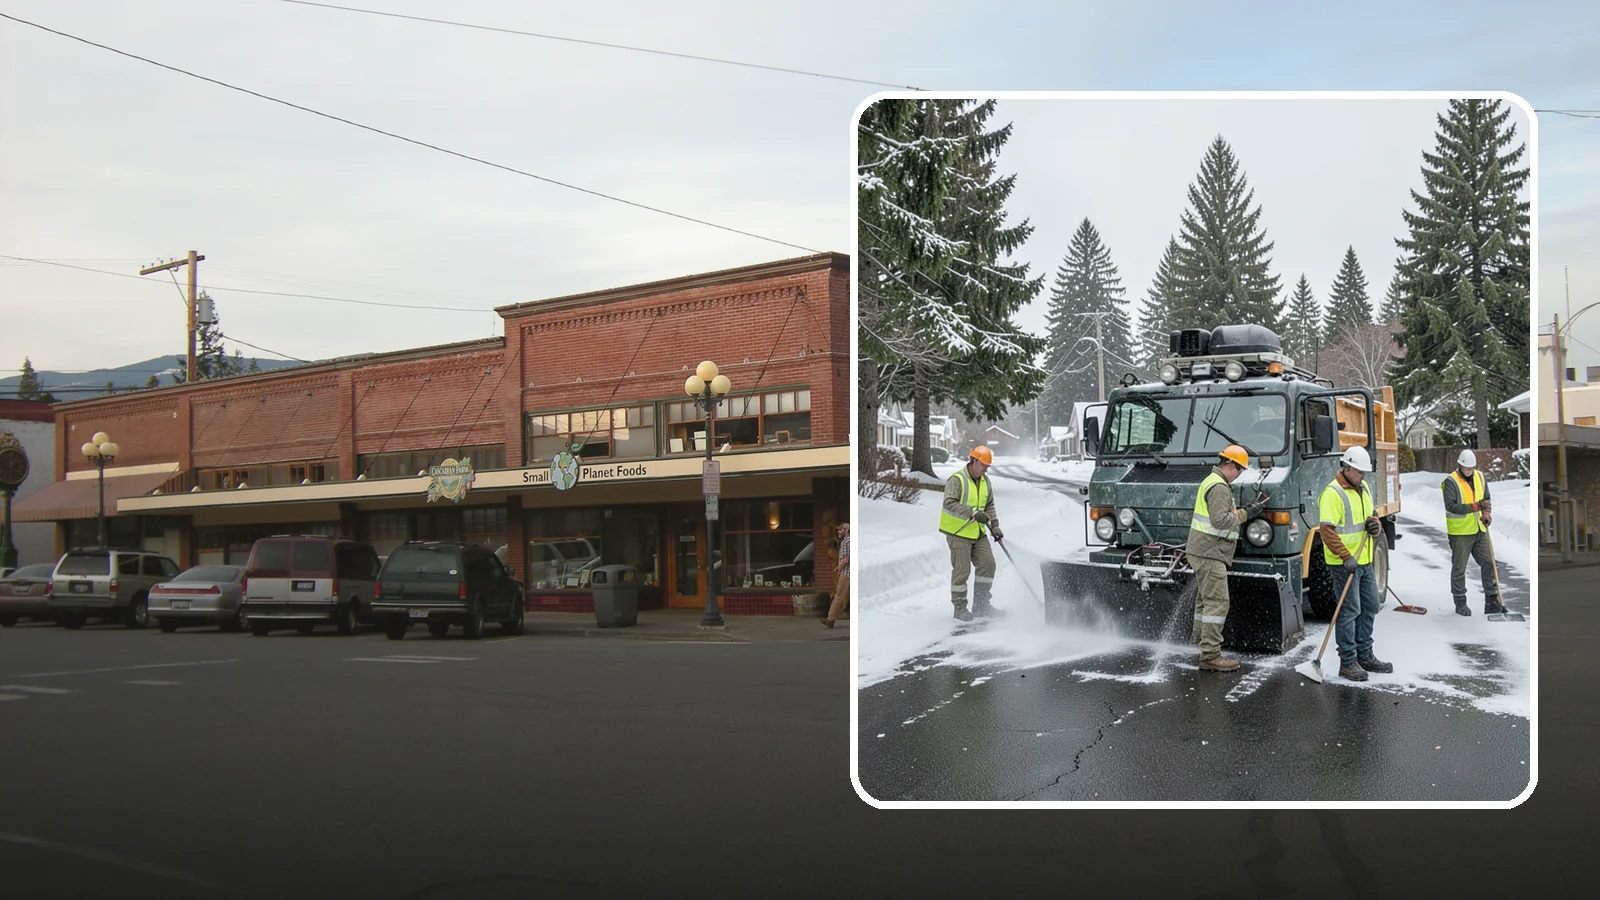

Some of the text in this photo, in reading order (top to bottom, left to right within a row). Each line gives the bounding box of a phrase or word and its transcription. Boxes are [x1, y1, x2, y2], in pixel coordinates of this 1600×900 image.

[431, 466, 469, 475] CASCADIAN FARM
[523, 464, 647, 483] Small Planet Foods
